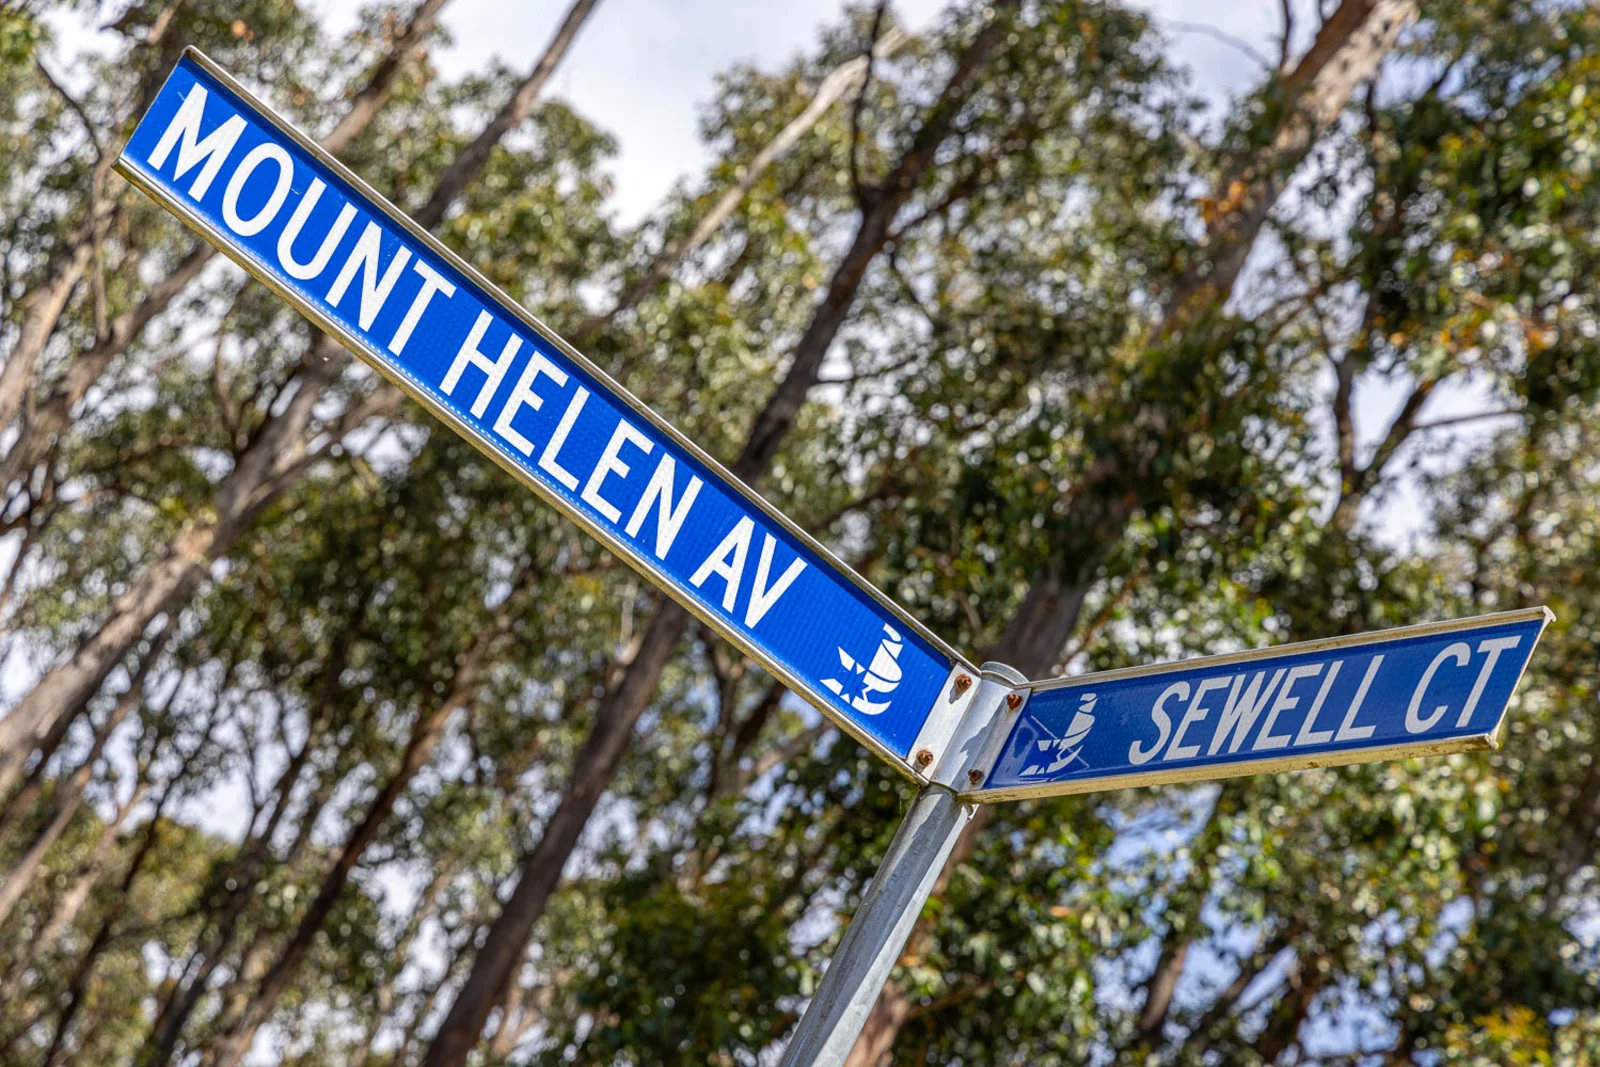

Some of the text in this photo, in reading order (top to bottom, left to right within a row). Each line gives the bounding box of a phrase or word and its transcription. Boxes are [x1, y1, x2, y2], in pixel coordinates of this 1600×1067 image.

[147, 83, 808, 629] MOUNT HELEN AV
[1128, 635, 1521, 766] SEWELL CT
